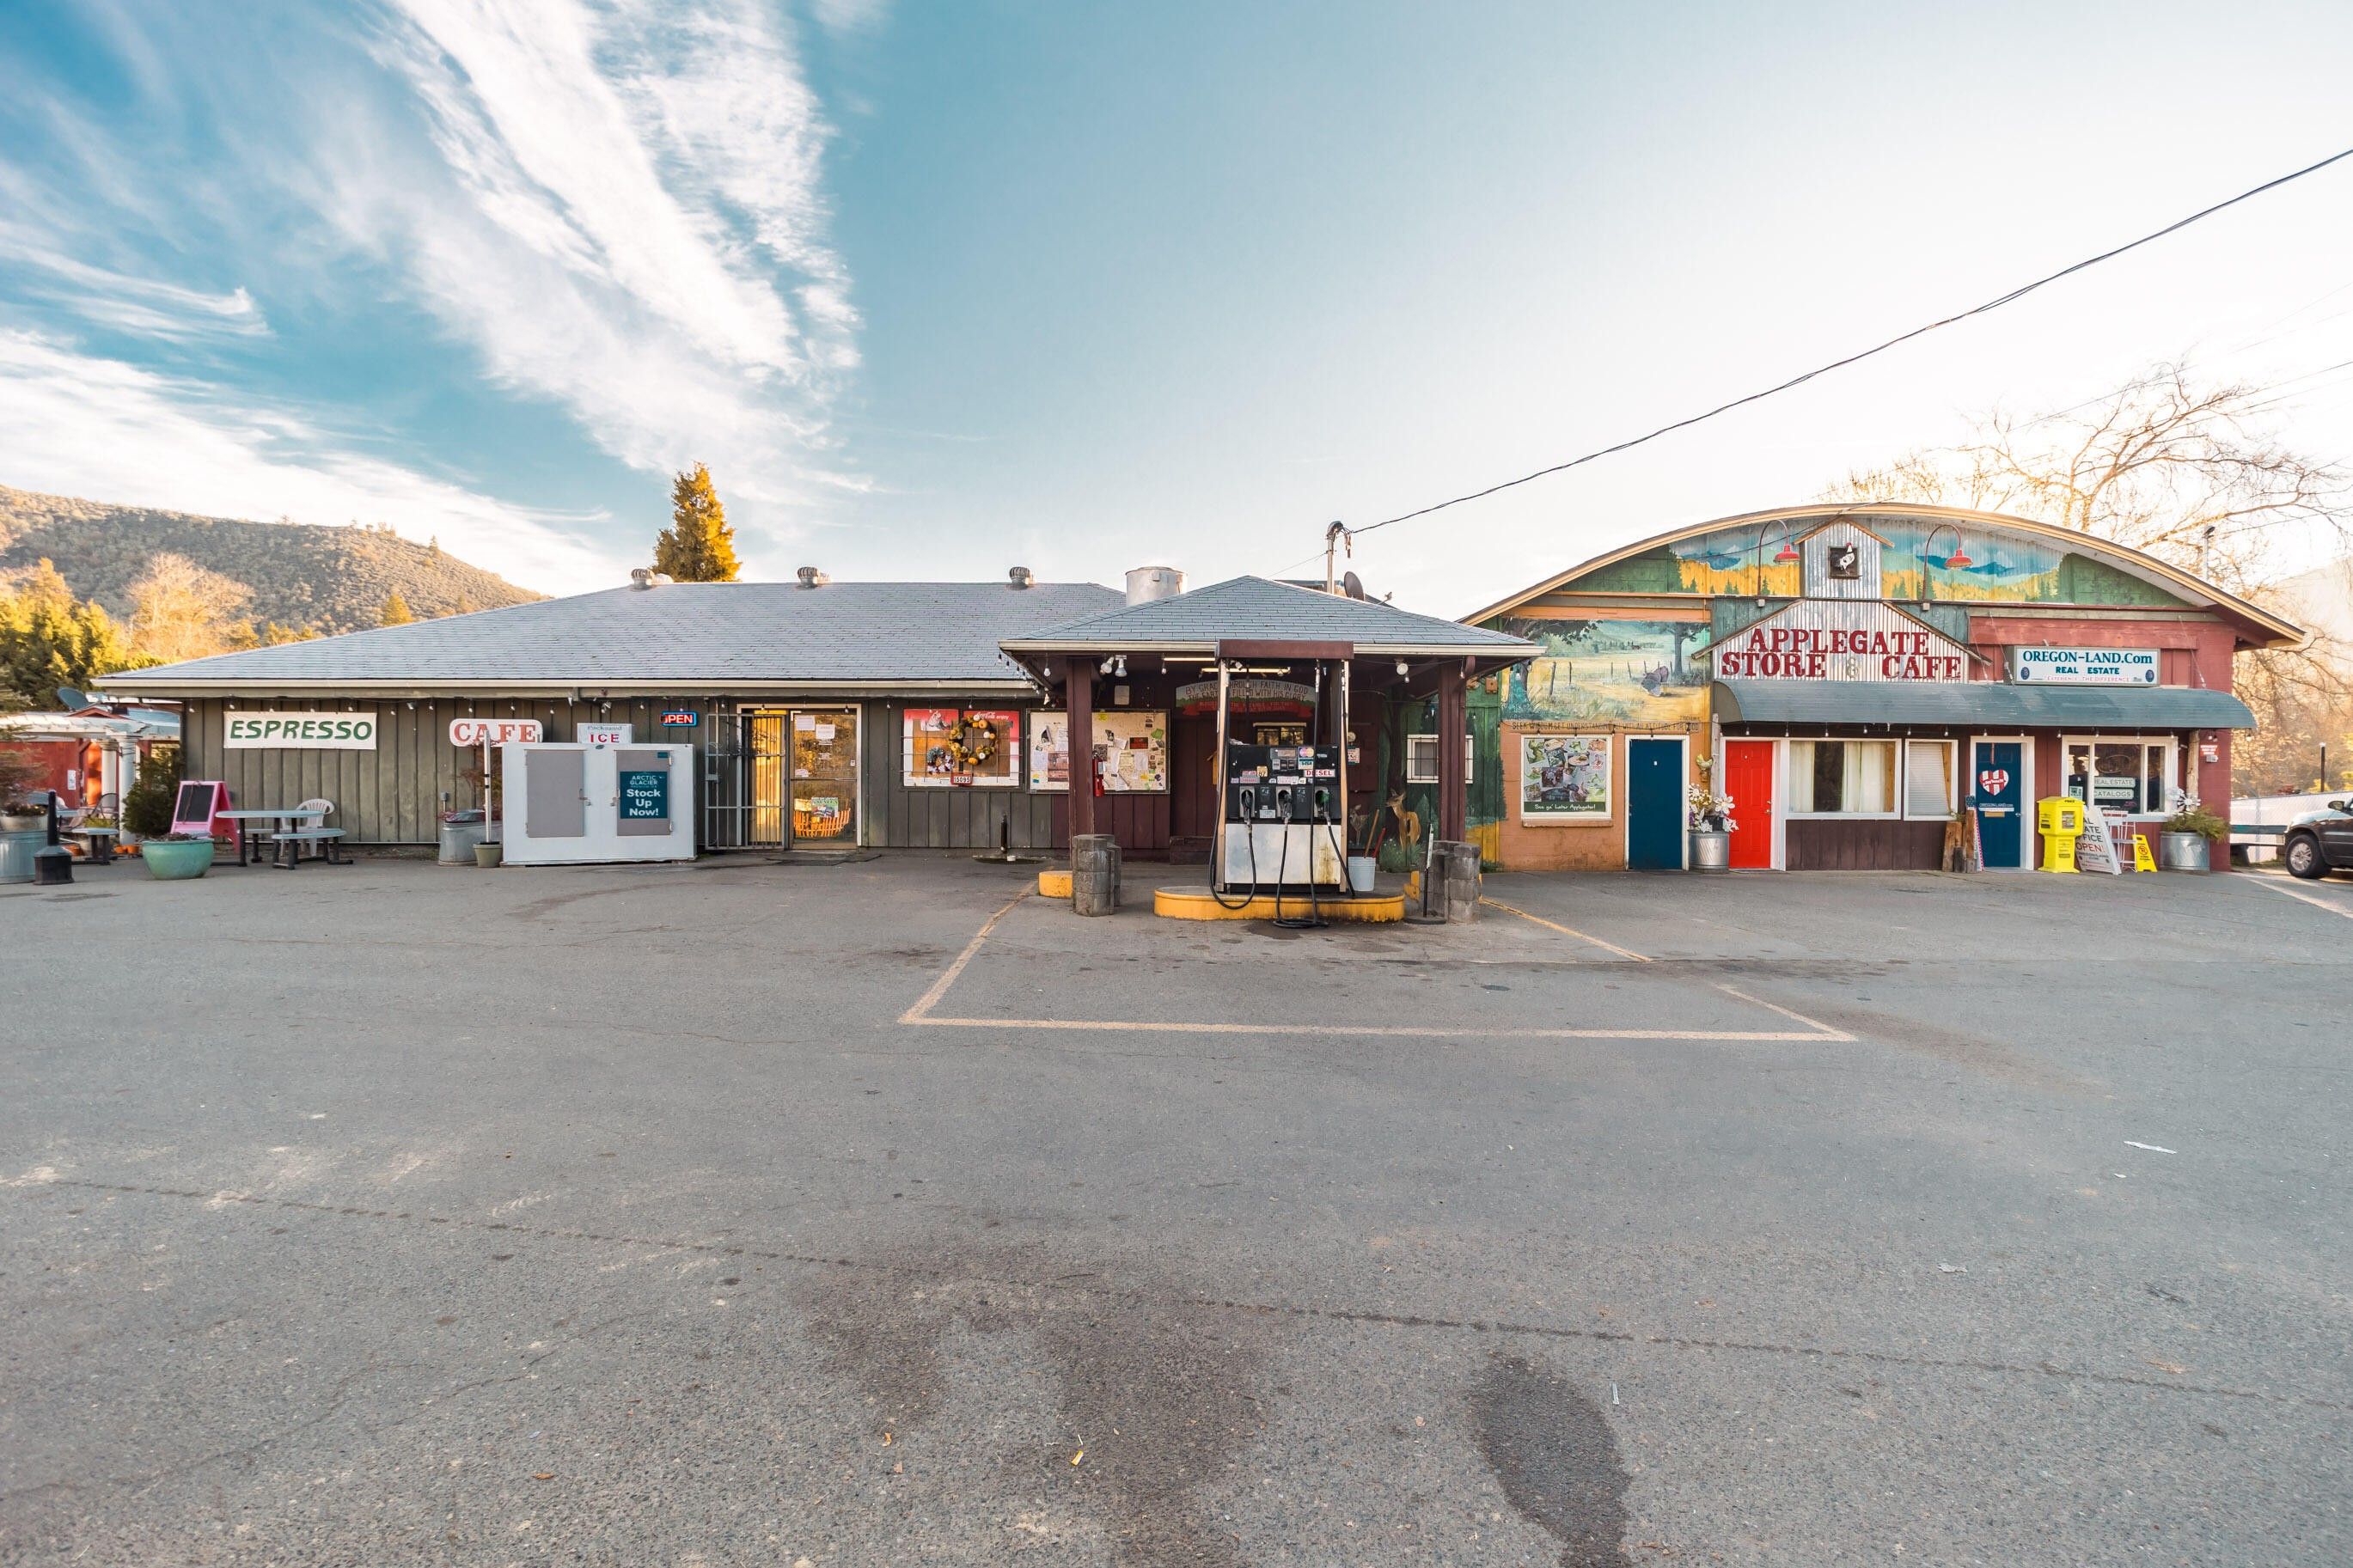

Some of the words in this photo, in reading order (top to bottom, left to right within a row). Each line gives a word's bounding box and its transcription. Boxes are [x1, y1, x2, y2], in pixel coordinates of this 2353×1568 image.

[1746, 628, 1929, 655] APPLEGATE
[2023, 650, 2153, 664] OREGON-LAND.Com
[1721, 652, 1826, 678] STORE
[1847, 656, 1859, 678] &
[1882, 656, 1961, 679] CAFE
[2056, 666, 2079, 674] REAL
[1186, 685, 1196, 695] BY
[1199, 683, 1219, 692] GRAC
[1261, 680, 1281, 689] FAITH
[1294, 684, 1309, 695] GOD
[1256, 688, 1272, 697] WITH
[230, 720, 373, 741] ESPRESSO
[590, 734, 620, 743] ICE
[626, 789, 661, 797] Stock
[635, 798, 652, 808] Up
[629, 808, 659, 816] Now!
[2075, 842, 2105, 853] OPEN!
